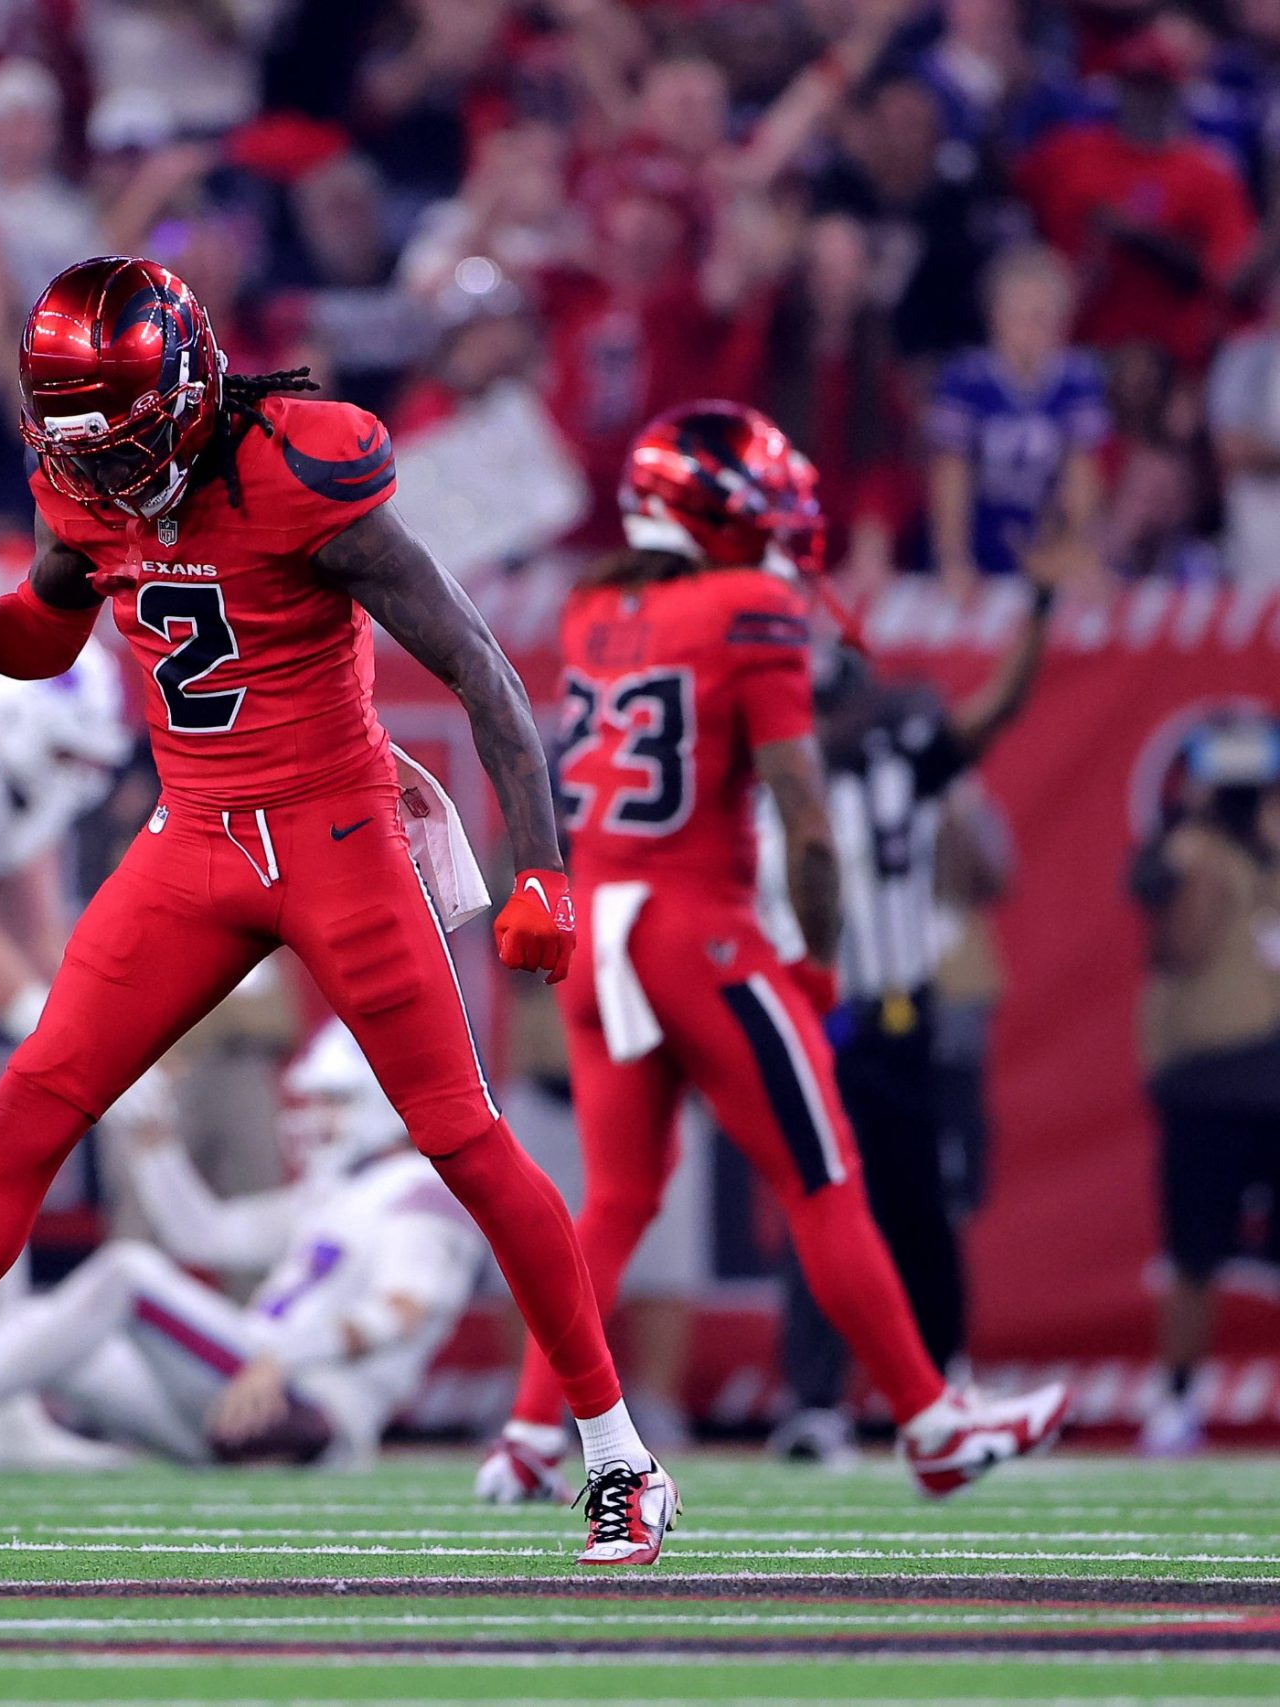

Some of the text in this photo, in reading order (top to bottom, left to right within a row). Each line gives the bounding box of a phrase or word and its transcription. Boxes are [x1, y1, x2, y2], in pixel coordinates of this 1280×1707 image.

[141, 560, 218, 577] EXANS
[136, 581, 247, 733] 2
[556, 664, 697, 838] 23
